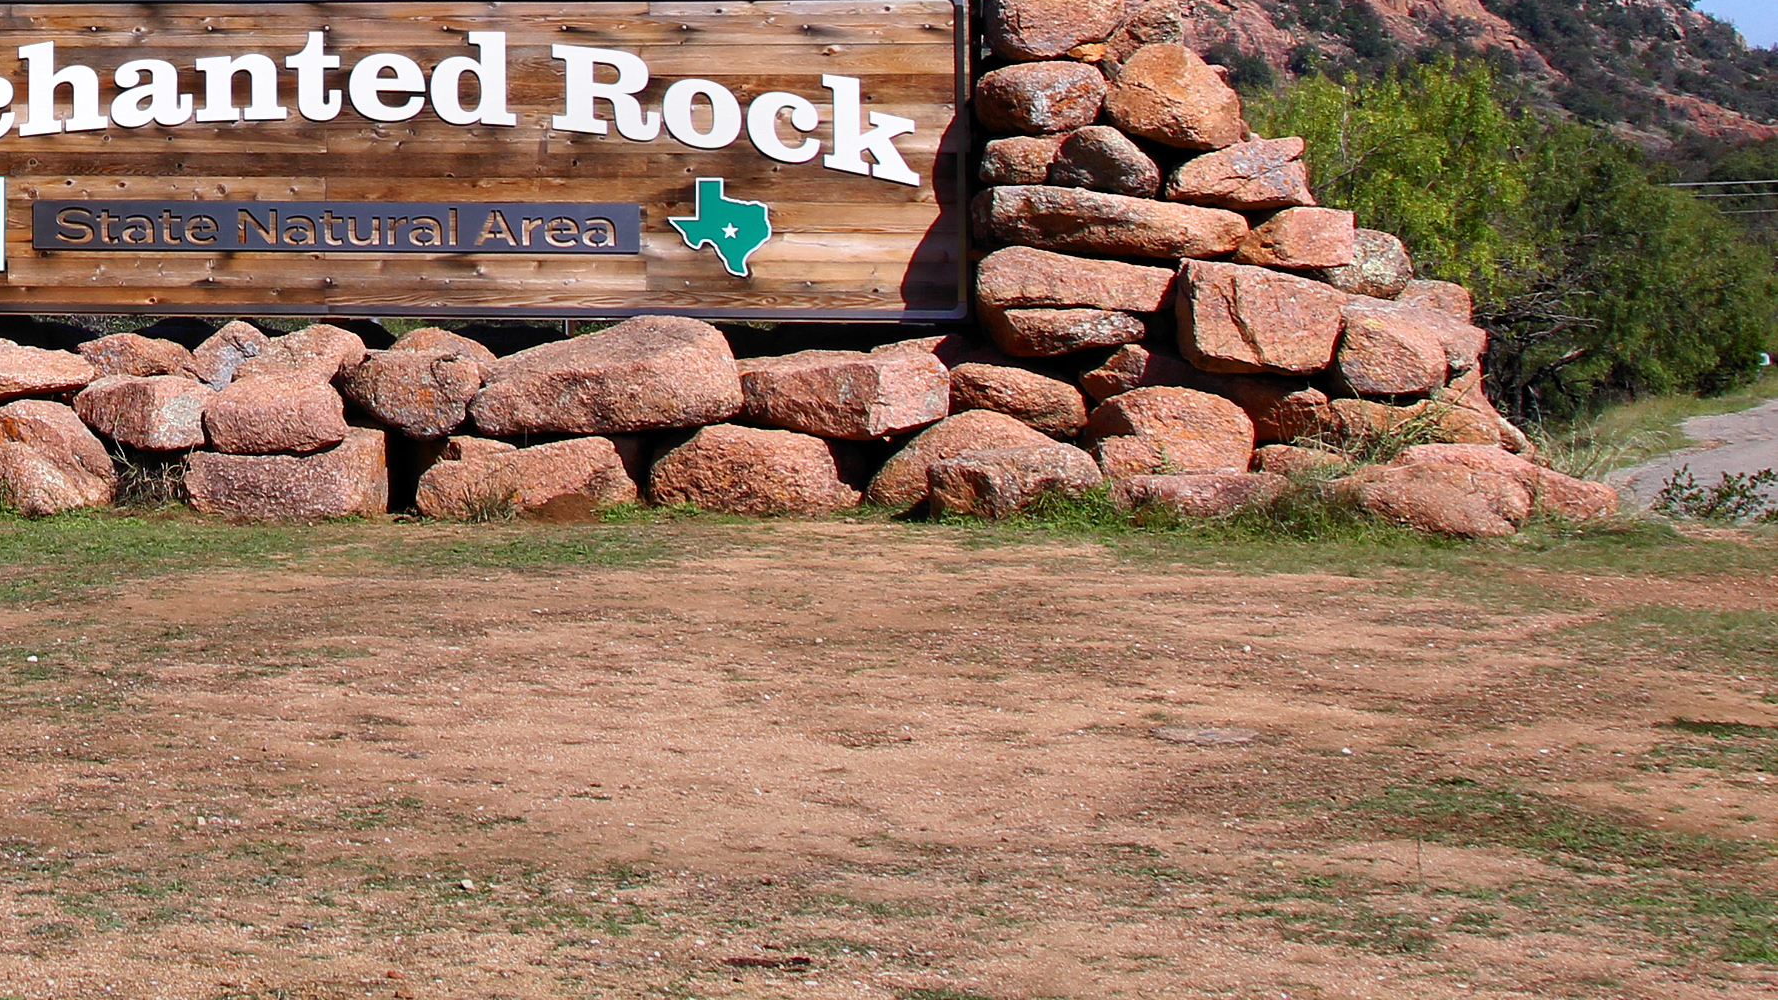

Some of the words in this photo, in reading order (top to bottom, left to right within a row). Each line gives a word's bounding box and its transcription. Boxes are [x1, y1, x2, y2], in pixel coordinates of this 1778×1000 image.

[551, 43, 920, 187] Rock
[55, 206, 220, 245] State
[236, 207, 459, 247] Natural
[473, 208, 618, 248] Area
